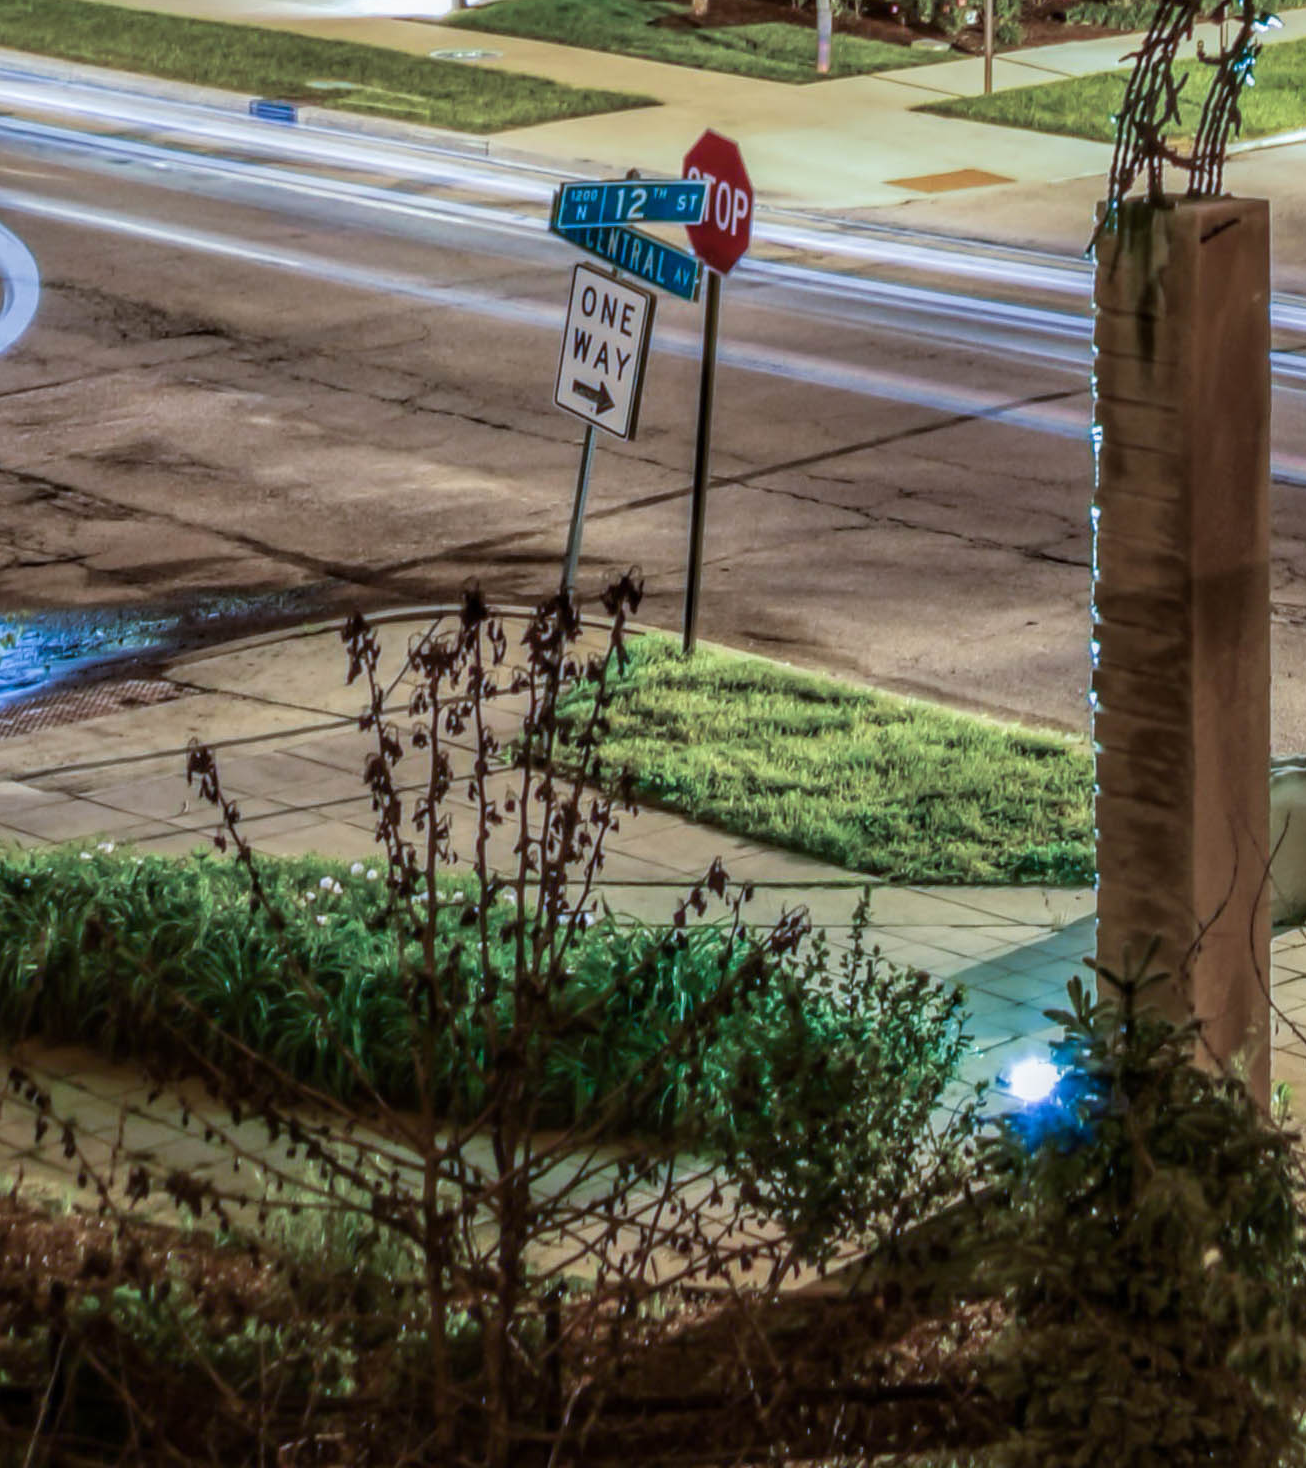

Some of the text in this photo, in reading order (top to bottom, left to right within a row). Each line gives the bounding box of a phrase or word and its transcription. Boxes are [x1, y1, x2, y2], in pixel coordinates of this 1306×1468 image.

[571, 188, 598, 202] 1200
[676, 194, 698, 212] ST
[688, 166, 749, 236] TOP
[576, 205, 587, 220] N
[673, 266, 691, 287] AV
[581, 285, 636, 338] ONE
[573, 327, 632, 382] WAY
